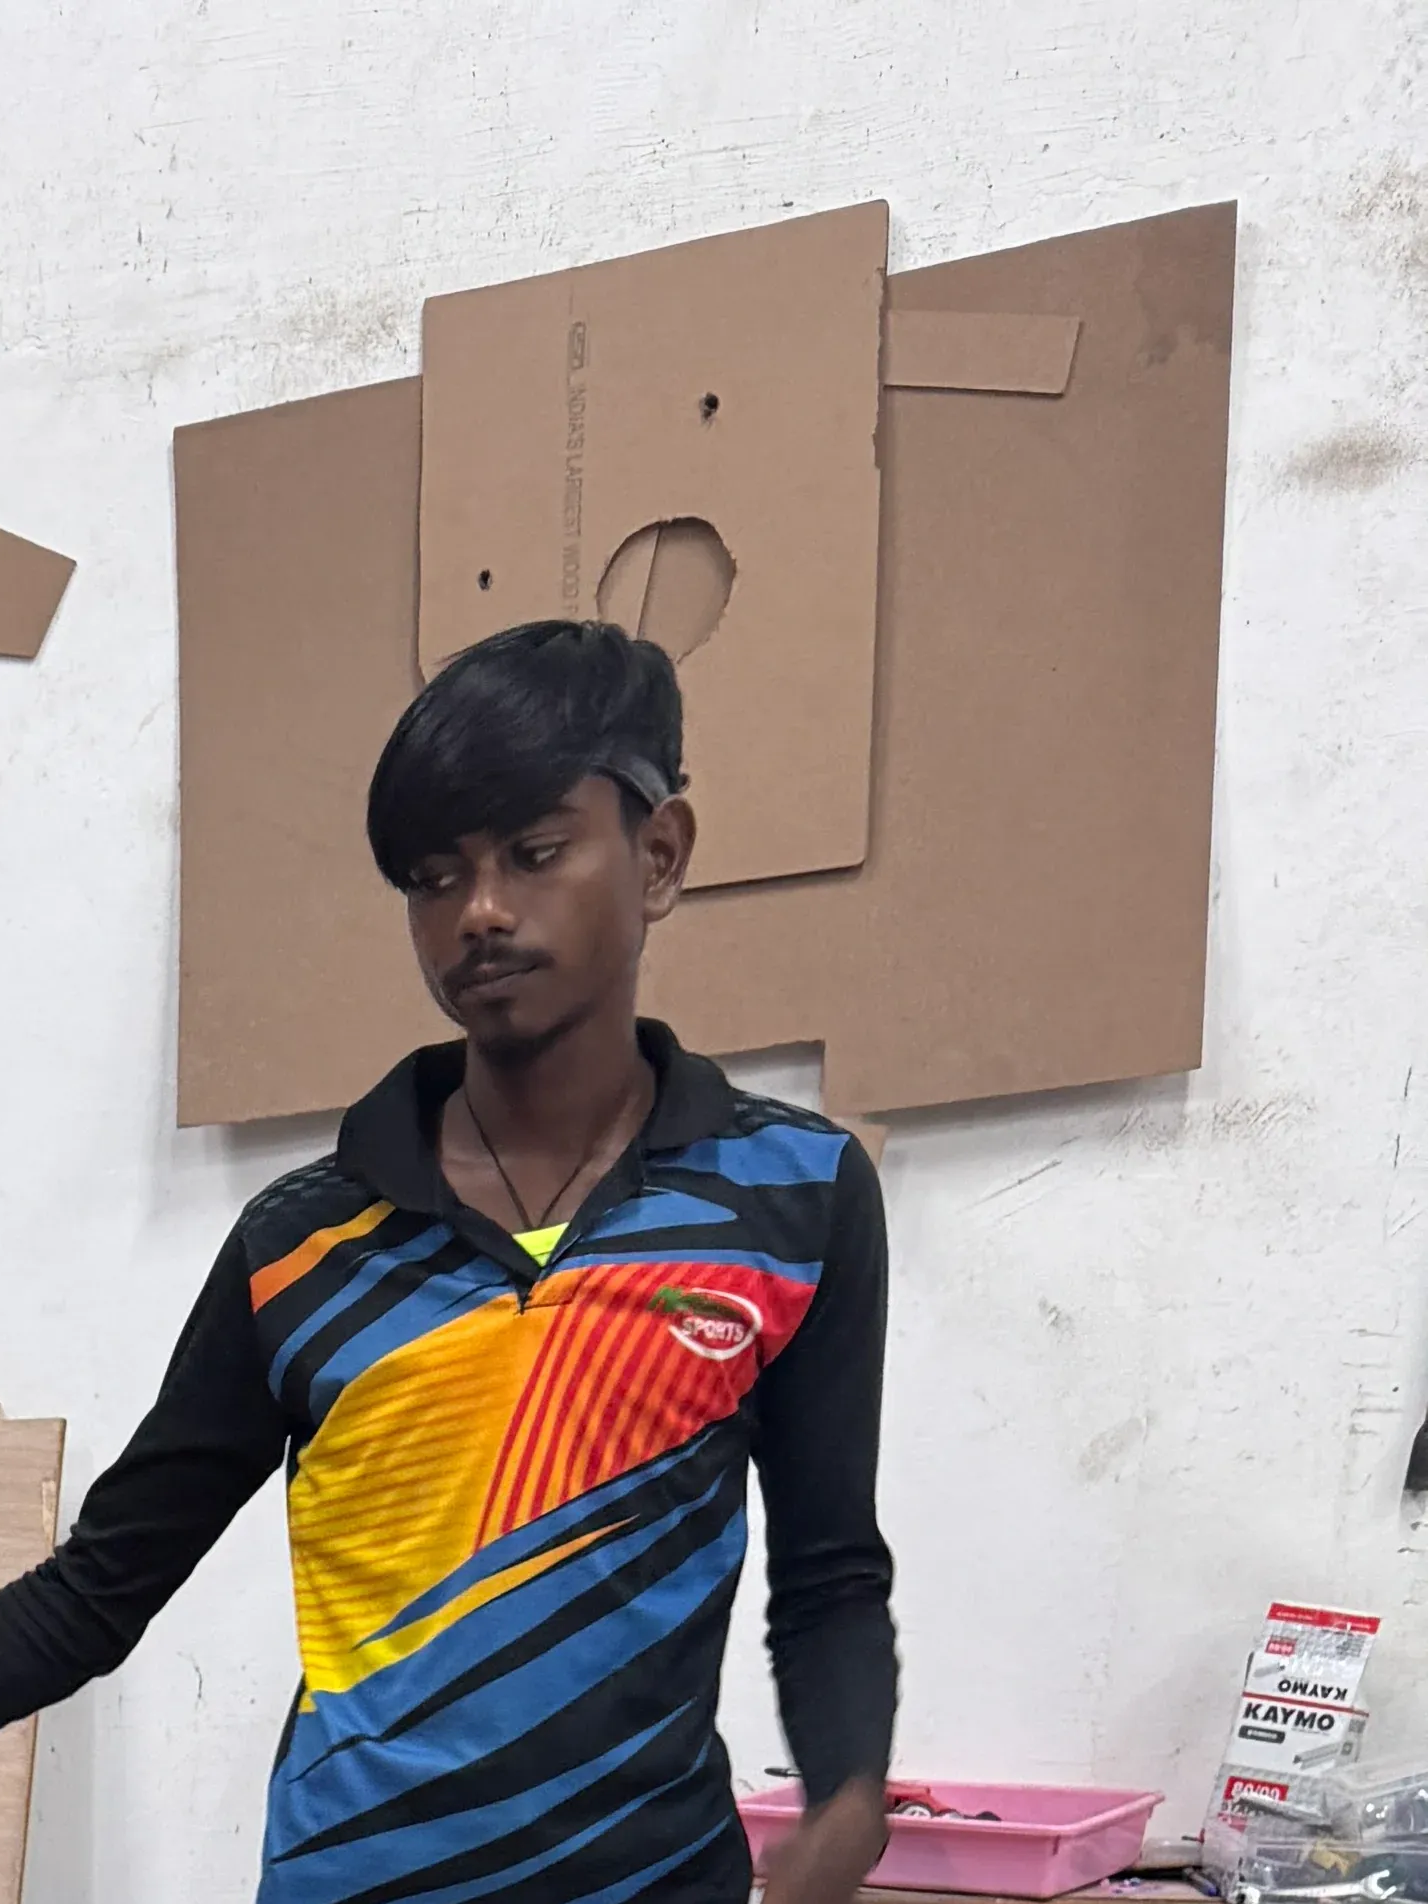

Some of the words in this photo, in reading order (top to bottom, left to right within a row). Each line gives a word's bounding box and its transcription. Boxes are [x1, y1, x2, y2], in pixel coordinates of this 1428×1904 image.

[681, 1315, 745, 1344] SPORTS
[1277, 1679, 1348, 1701] KAYMO
[1243, 1702, 1336, 1731] KAYMO
